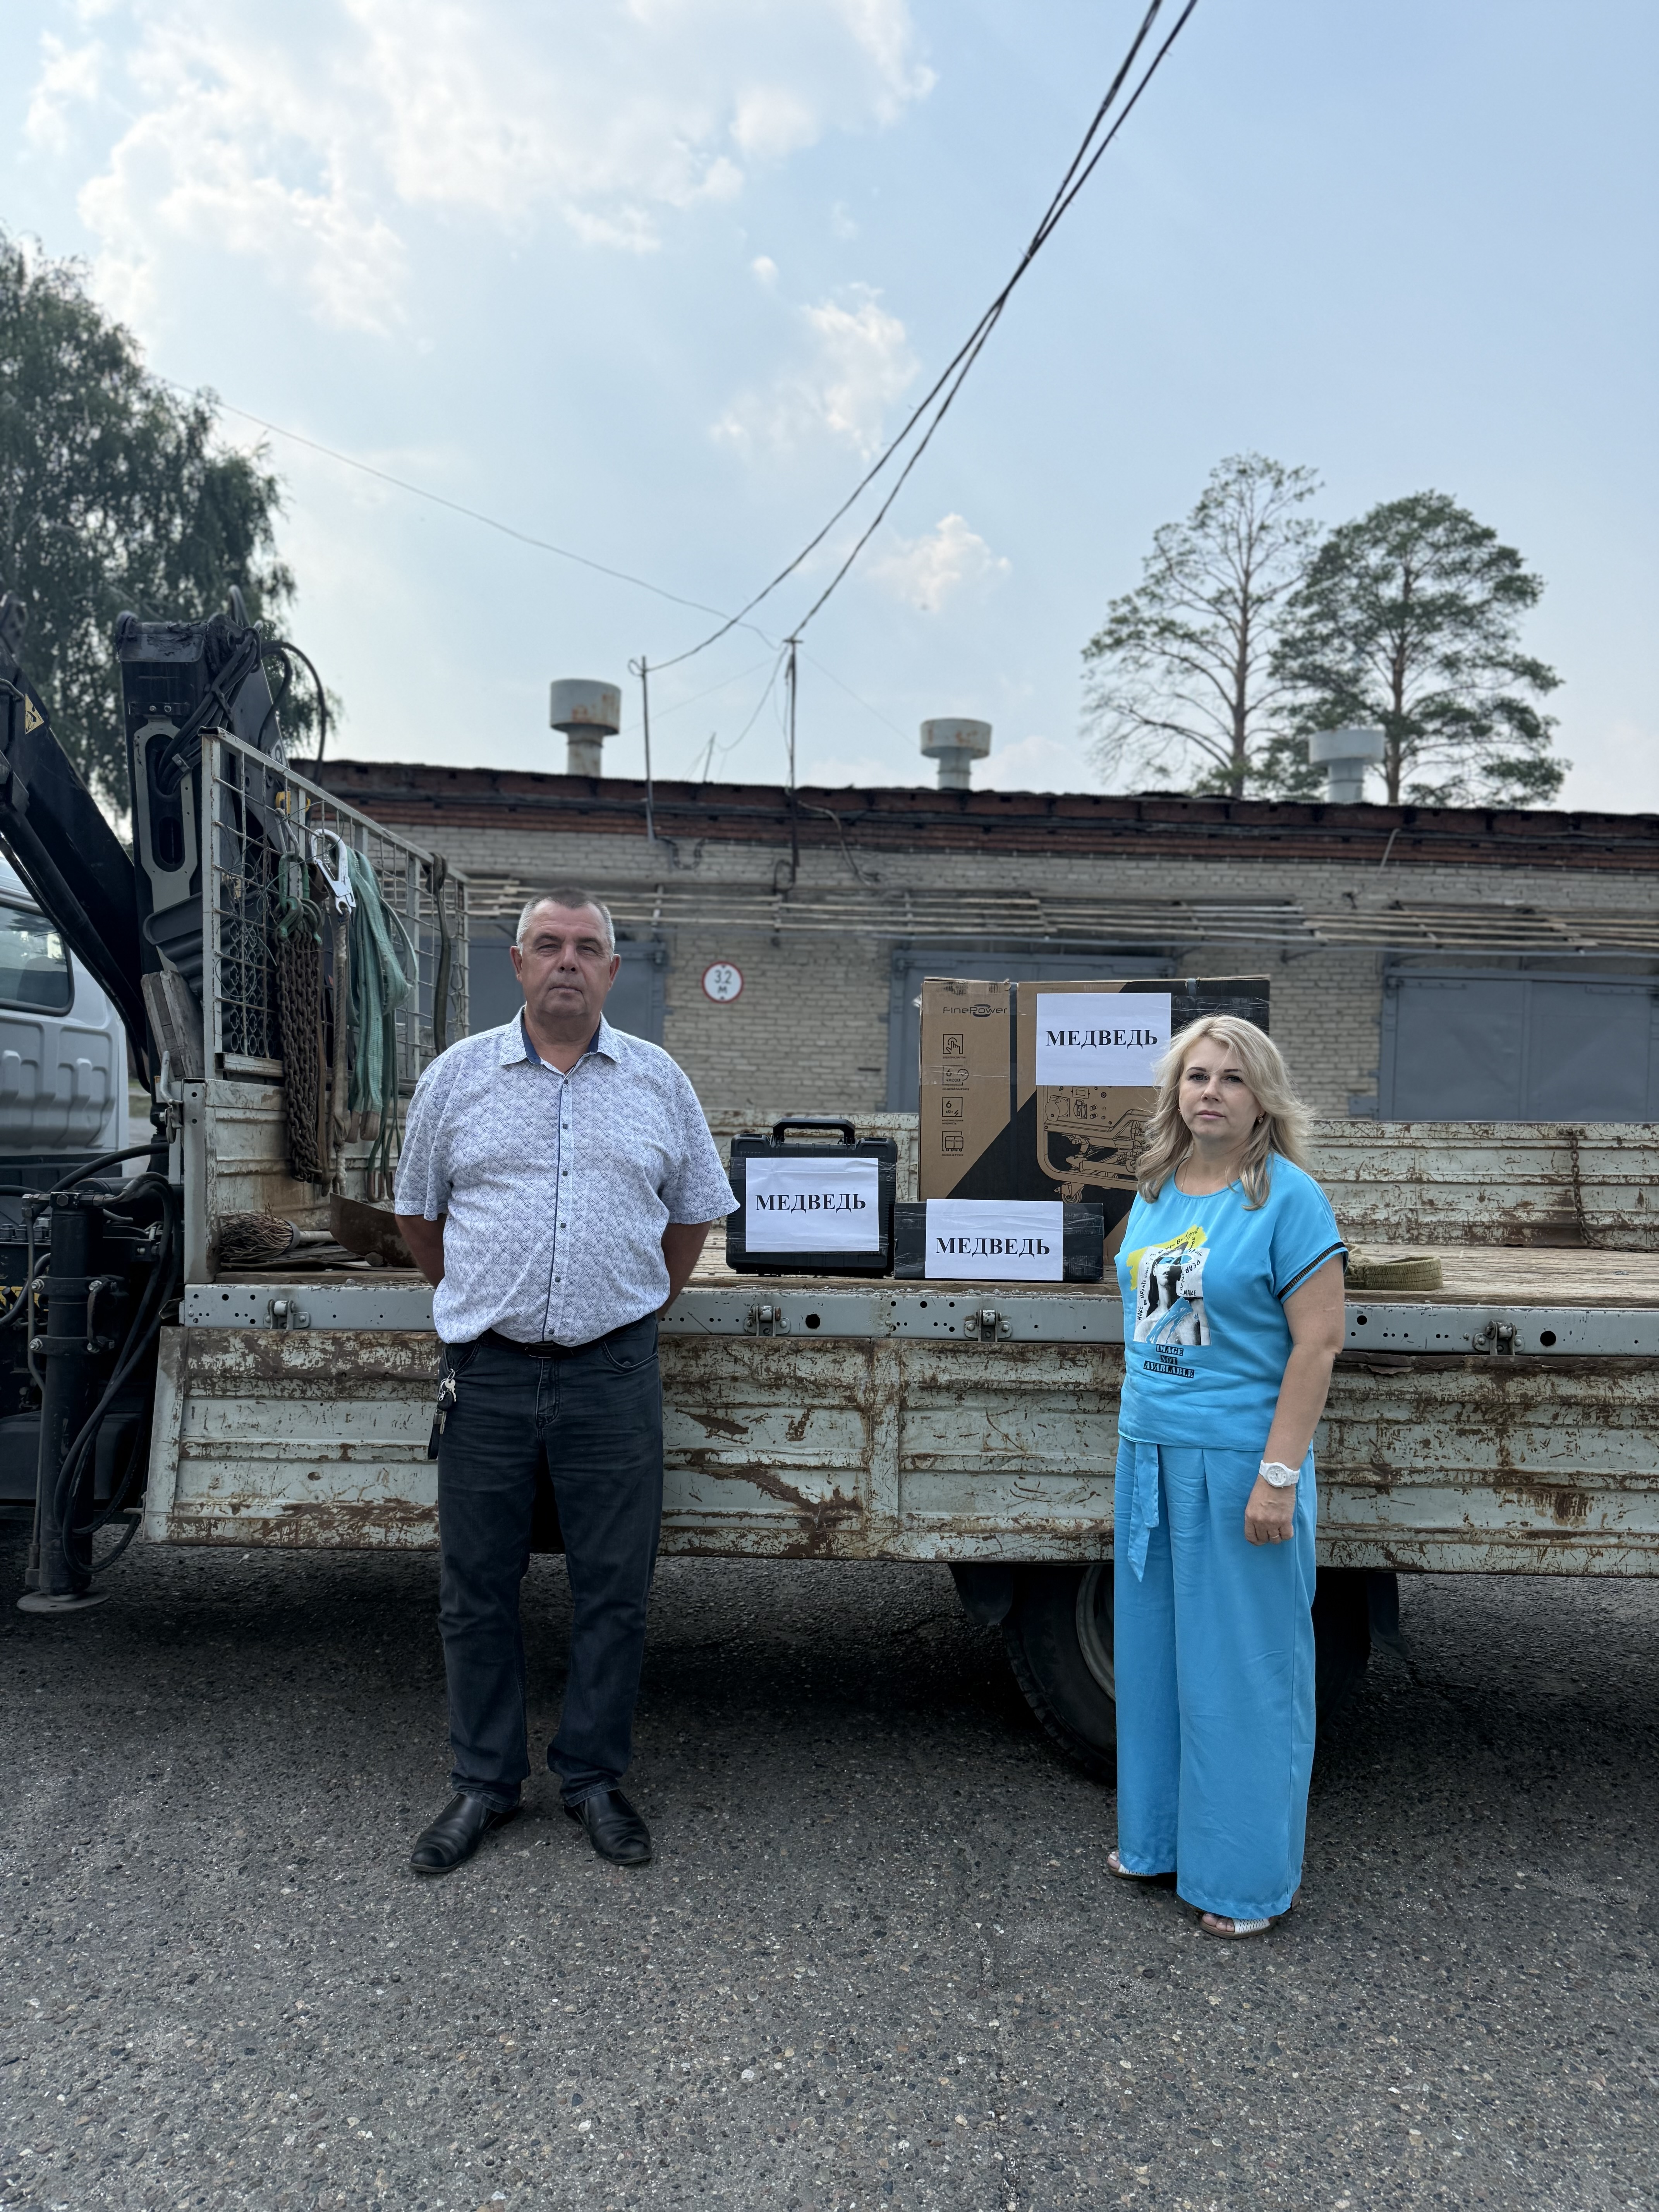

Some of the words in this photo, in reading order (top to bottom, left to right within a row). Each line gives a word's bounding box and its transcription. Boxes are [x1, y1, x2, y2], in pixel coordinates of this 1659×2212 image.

[1046, 1029, 1158, 1049] МЕДВЕДЬ
[756, 1194, 866, 1214] МЕДВЕДЬ
[936, 1238, 1050, 1259] МЕДВЕДЬ
[1156, 1345, 1183, 1355] IMAGE
[1161, 1356, 1177, 1364] NOT
